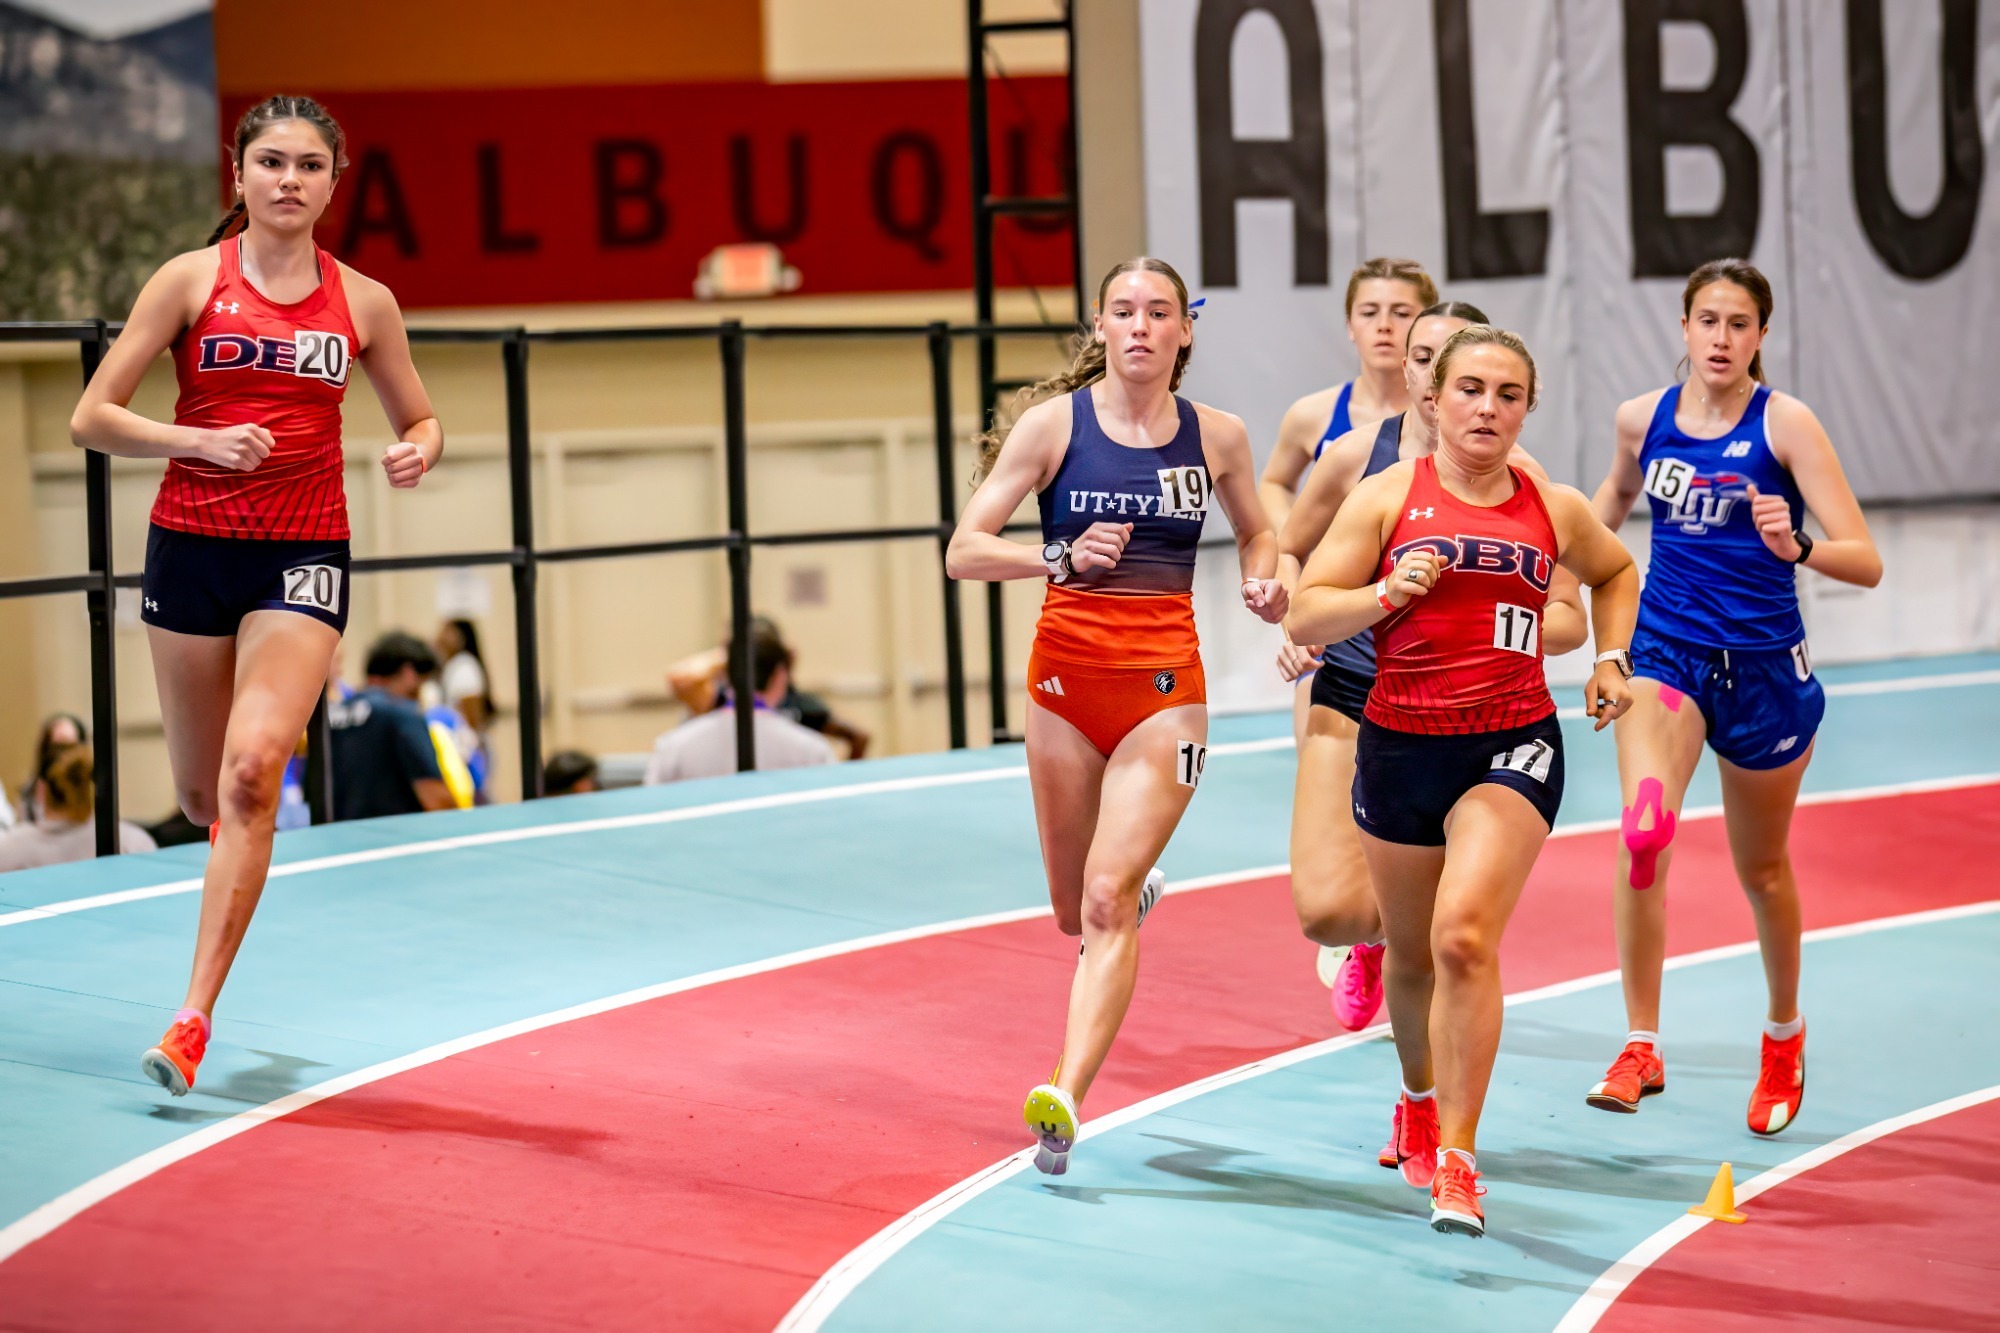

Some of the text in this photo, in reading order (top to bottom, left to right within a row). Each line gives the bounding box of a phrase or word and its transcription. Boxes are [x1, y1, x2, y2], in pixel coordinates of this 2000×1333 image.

[299, 333, 343, 378] 20
[1163, 469, 1203, 509] 19
[1651, 460, 1686, 498] 15
[287, 566, 333, 607] 20
[1500, 607, 1534, 651] 17
